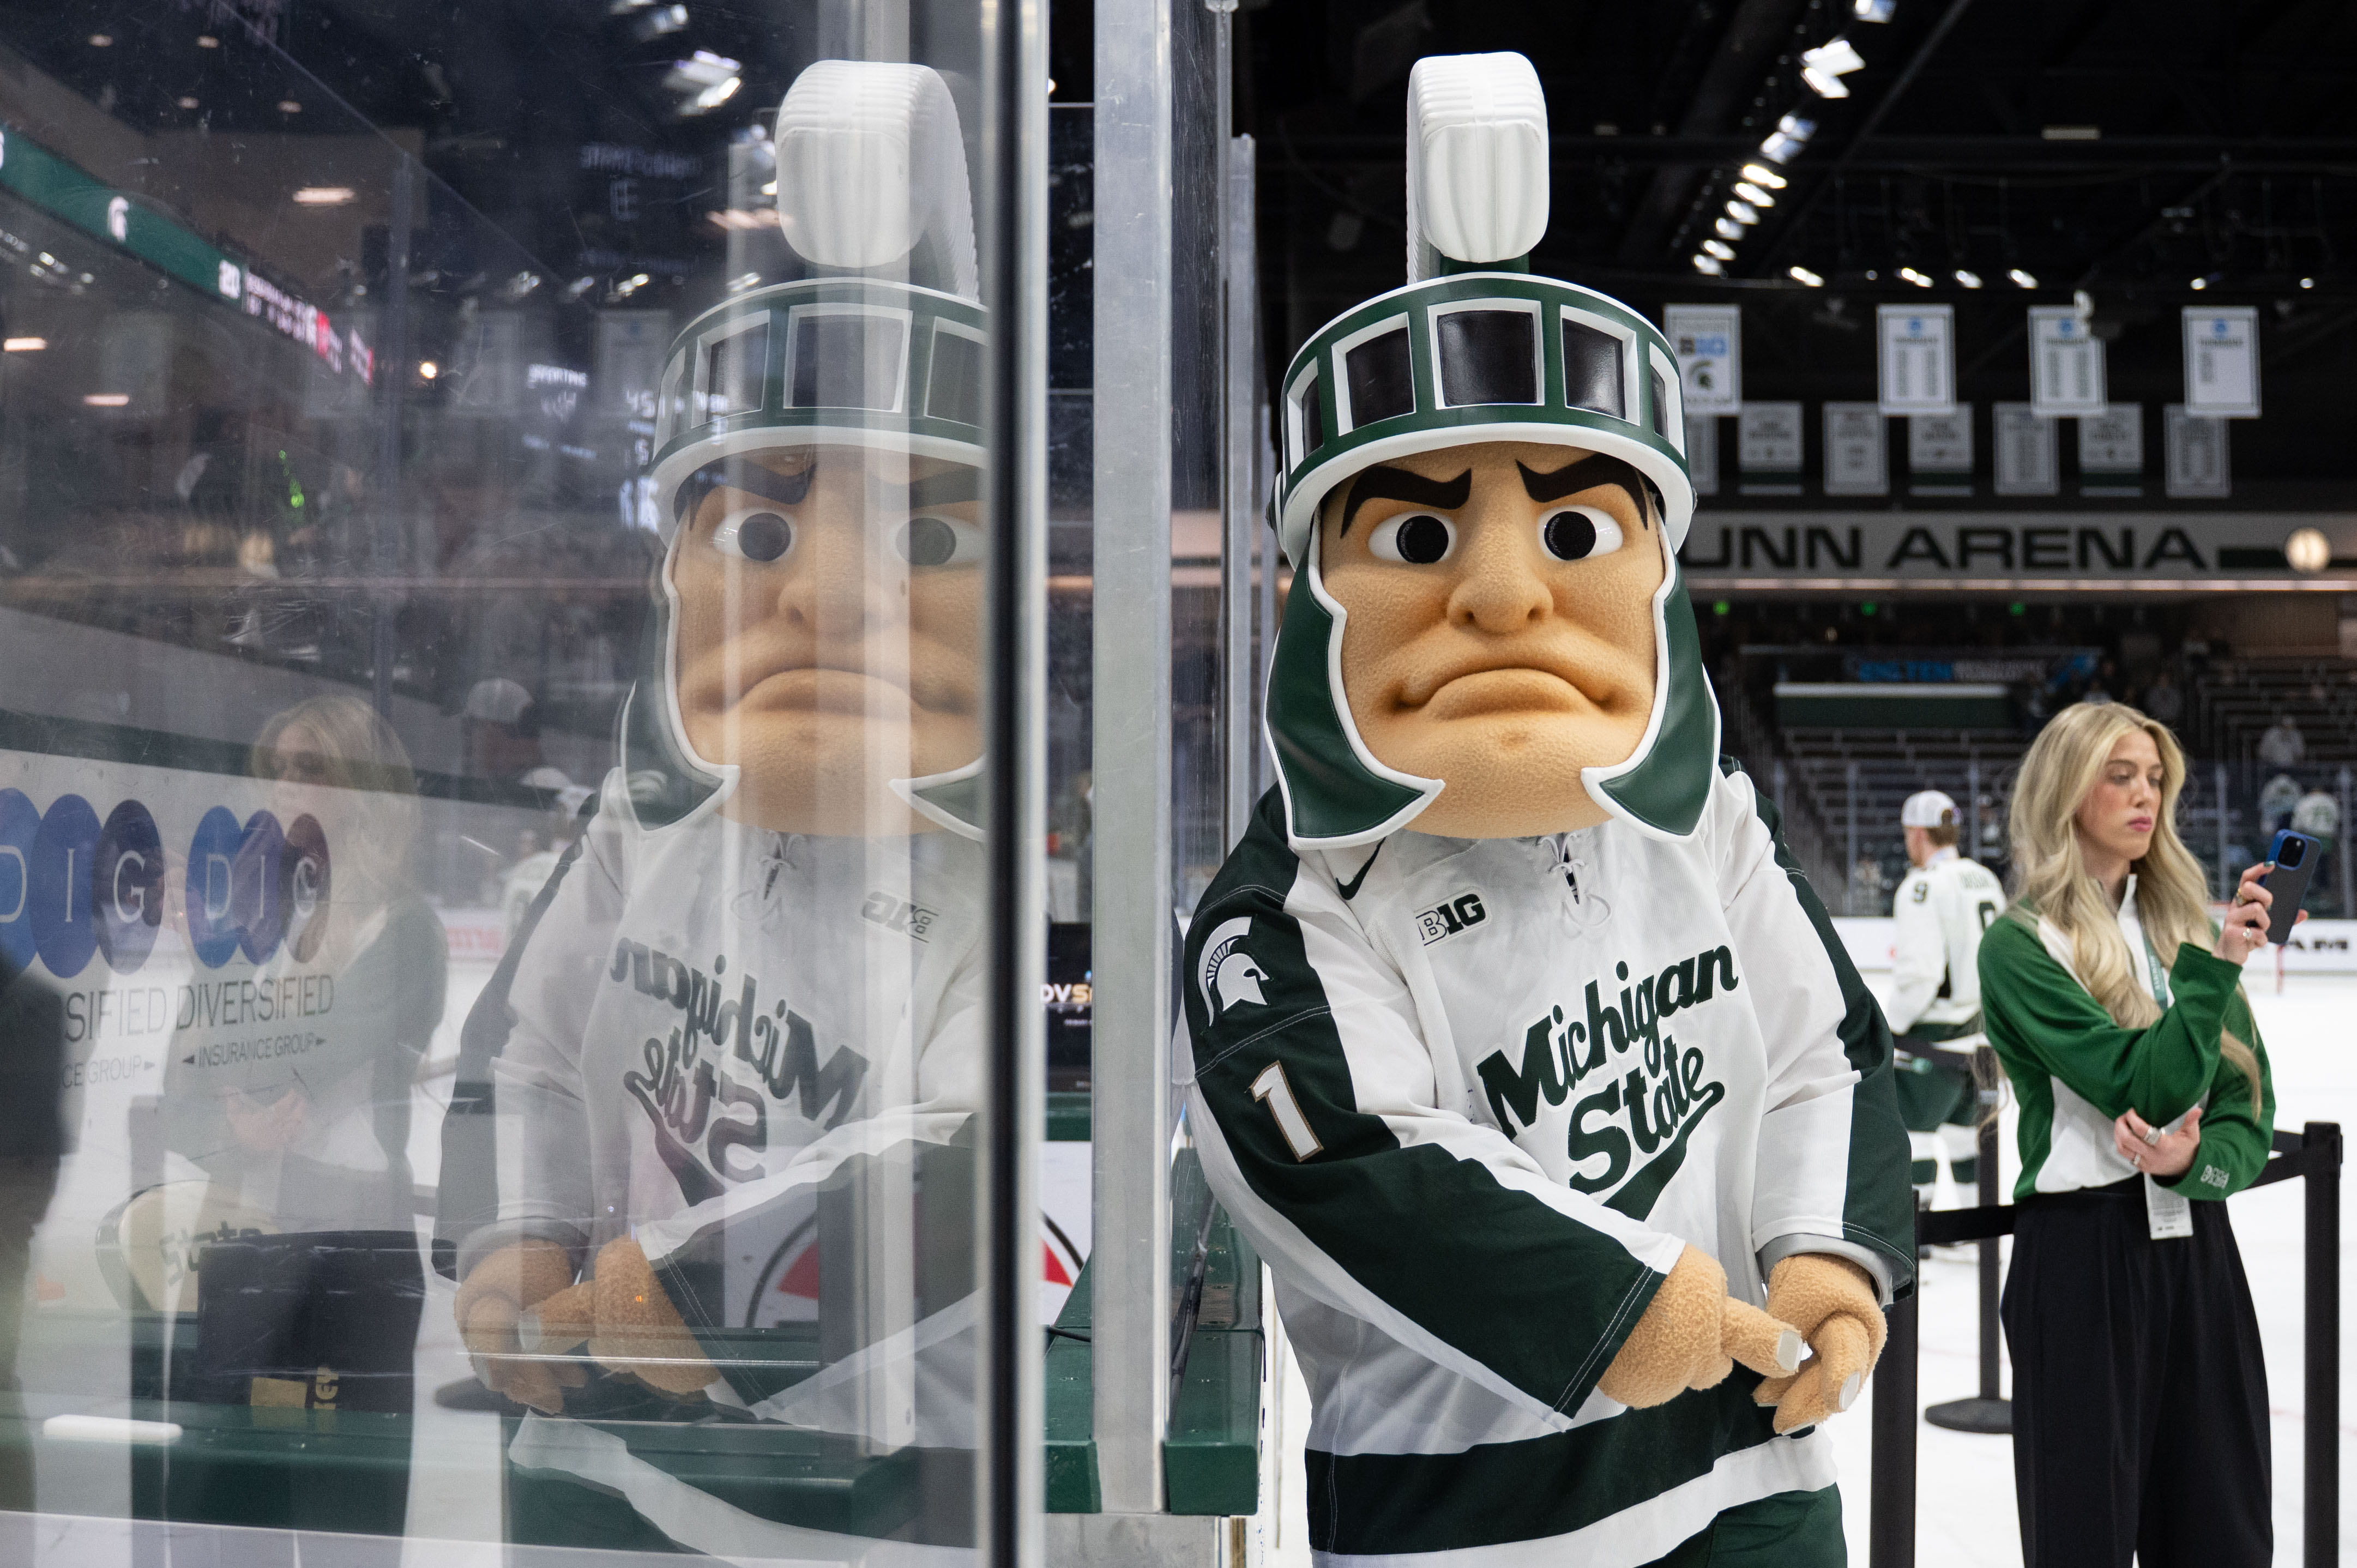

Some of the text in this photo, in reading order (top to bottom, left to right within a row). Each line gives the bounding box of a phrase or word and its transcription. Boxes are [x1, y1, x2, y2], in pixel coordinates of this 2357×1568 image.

[1886, 526, 2208, 571] ARENA
[204, 853, 318, 920] DIG
[176, 974, 334, 1030] DIVERSIFIED
[1040, 983, 1092, 1004] DVS
[87, 1055, 142, 1084] GROUP
[198, 1037, 273, 1068] INSURANCE
[1476, 944, 1739, 1141] Michigan
[1250, 1059, 1324, 1162] 1
[1568, 1034, 1725, 1195] State
